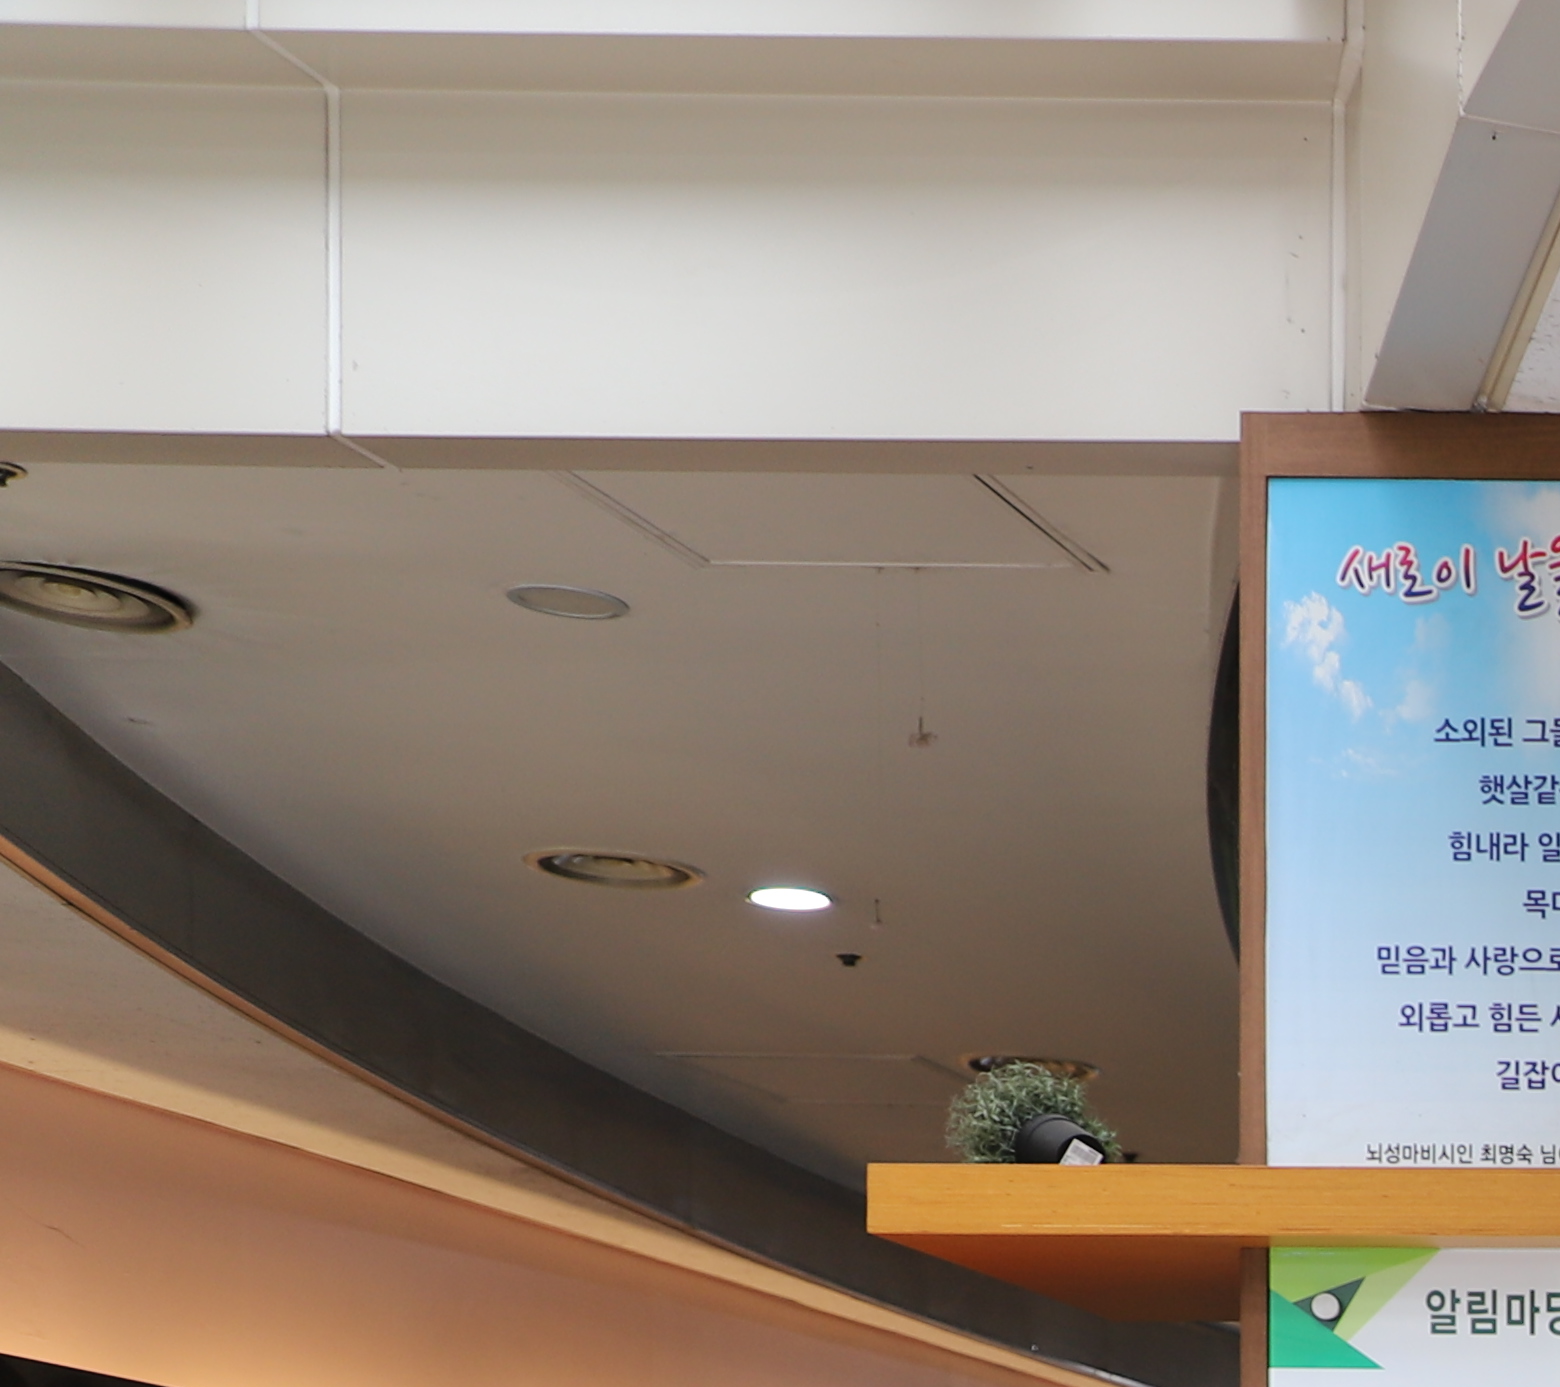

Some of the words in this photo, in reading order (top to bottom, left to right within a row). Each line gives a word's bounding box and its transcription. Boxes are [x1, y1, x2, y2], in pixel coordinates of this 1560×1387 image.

[1338, 542, 1478, 602] 새로이
[1434, 717, 1513, 748] 소외된
[1377, 945, 1457, 976] 믿음과
[1367, 1143, 1473, 1165] 뇌성마비시인
[1482, 1144, 1533, 1165] 최명숙
